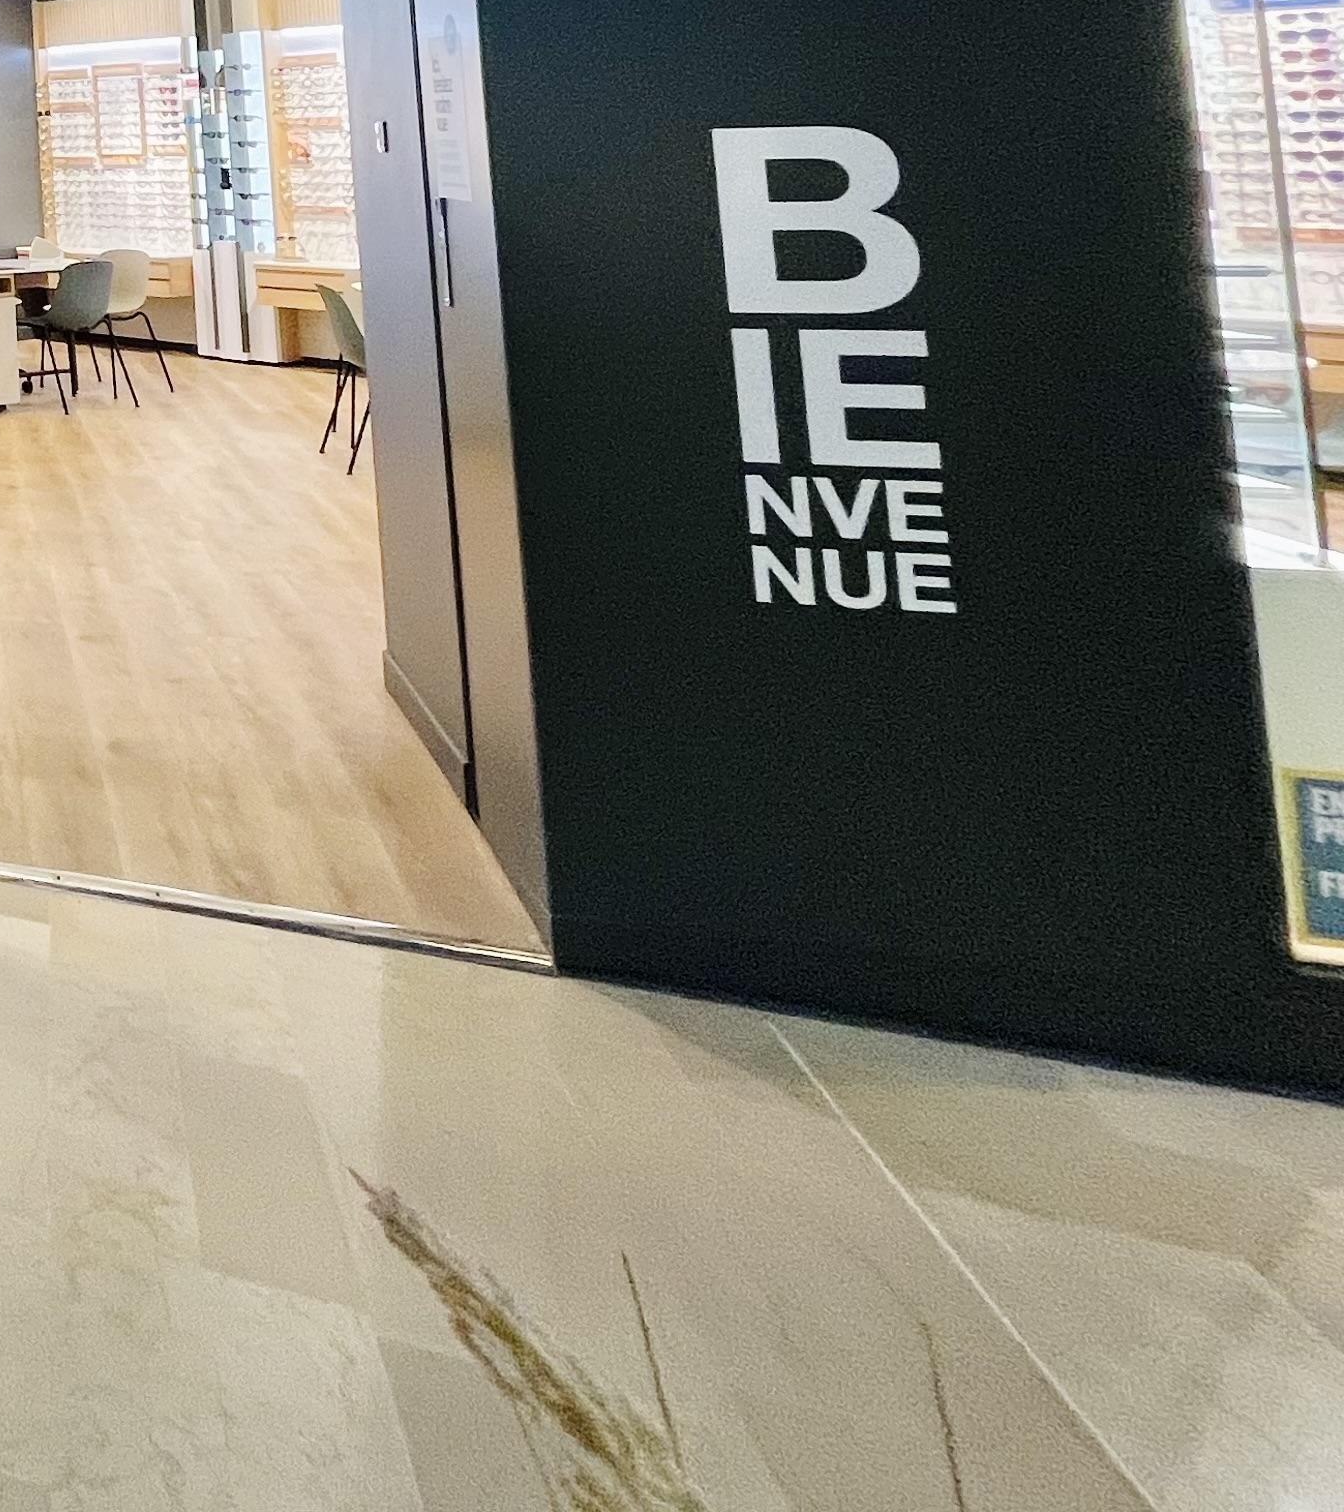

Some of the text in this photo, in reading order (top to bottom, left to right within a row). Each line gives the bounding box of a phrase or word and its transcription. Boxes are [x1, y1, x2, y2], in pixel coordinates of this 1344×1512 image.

[710, 125, 921, 314] B
[730, 328, 942, 469] IE
[744, 474, 949, 543] NVE
[751, 545, 958, 614] NUE
